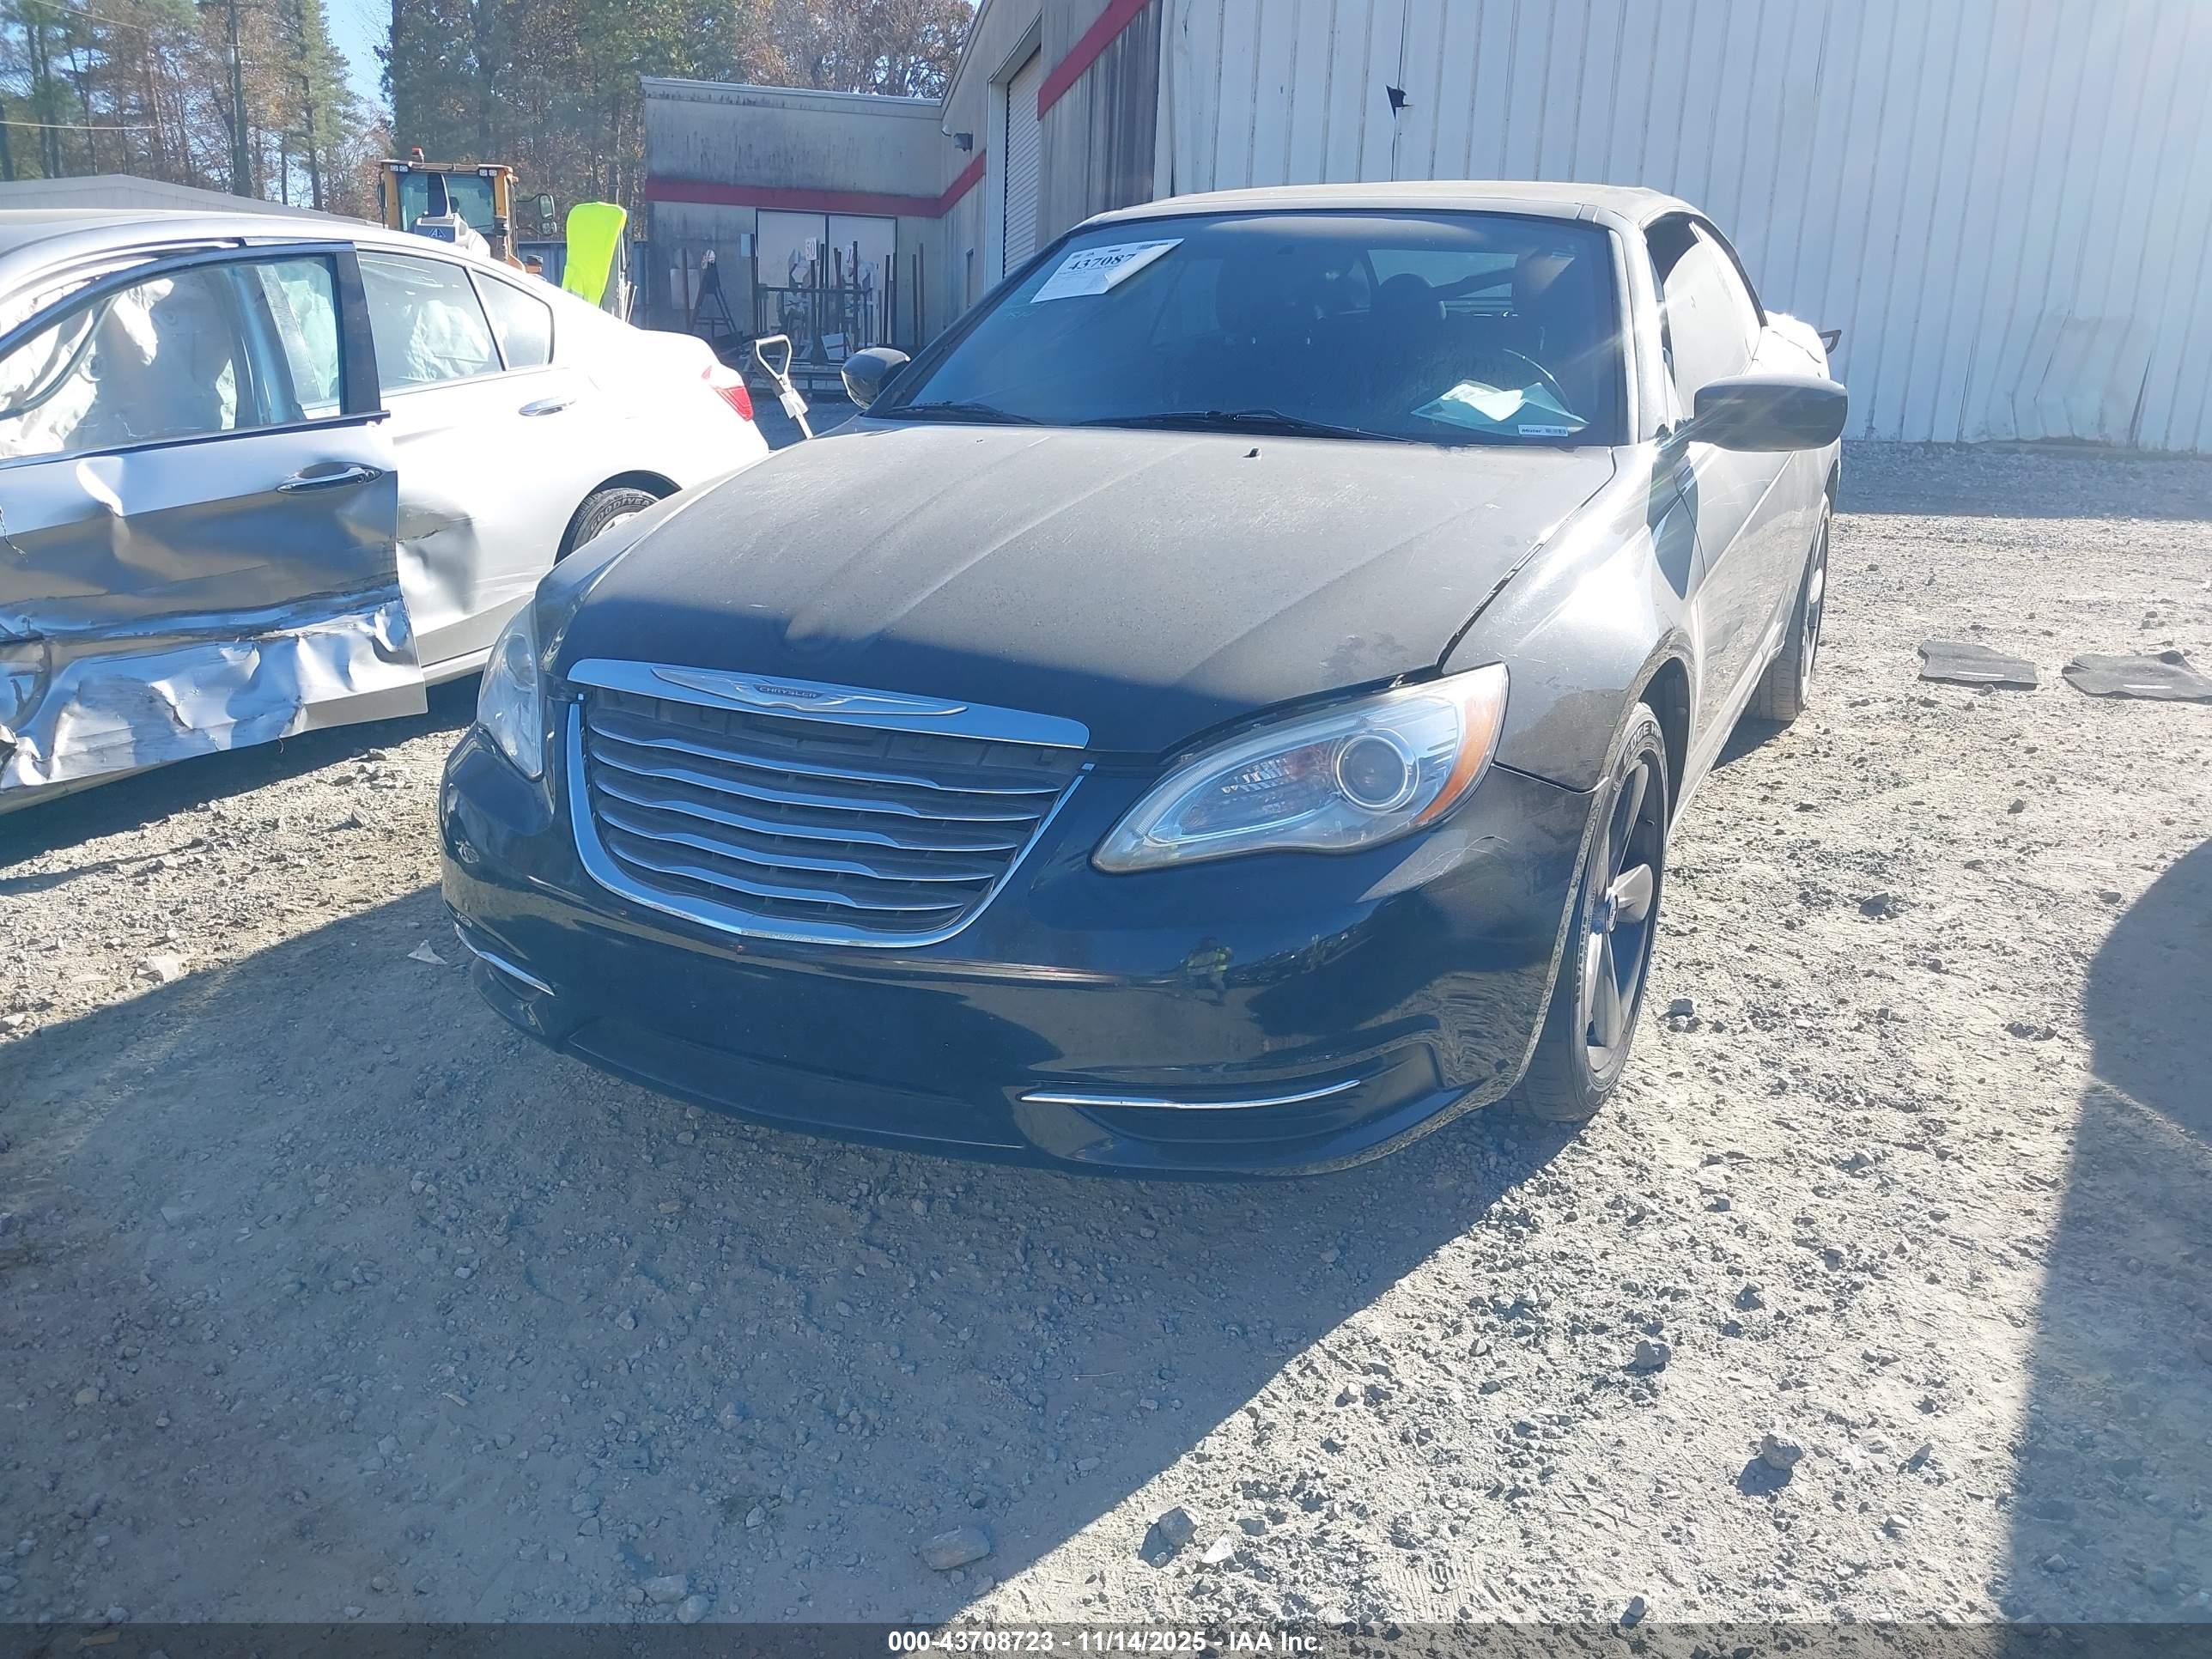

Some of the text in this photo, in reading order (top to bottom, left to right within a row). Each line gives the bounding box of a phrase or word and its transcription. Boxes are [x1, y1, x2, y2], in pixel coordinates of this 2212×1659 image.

[590, 497, 650, 532] GOODYEA
[759, 686, 817, 699] CHRYSLER
[1624, 722, 1650, 767] EDGE
